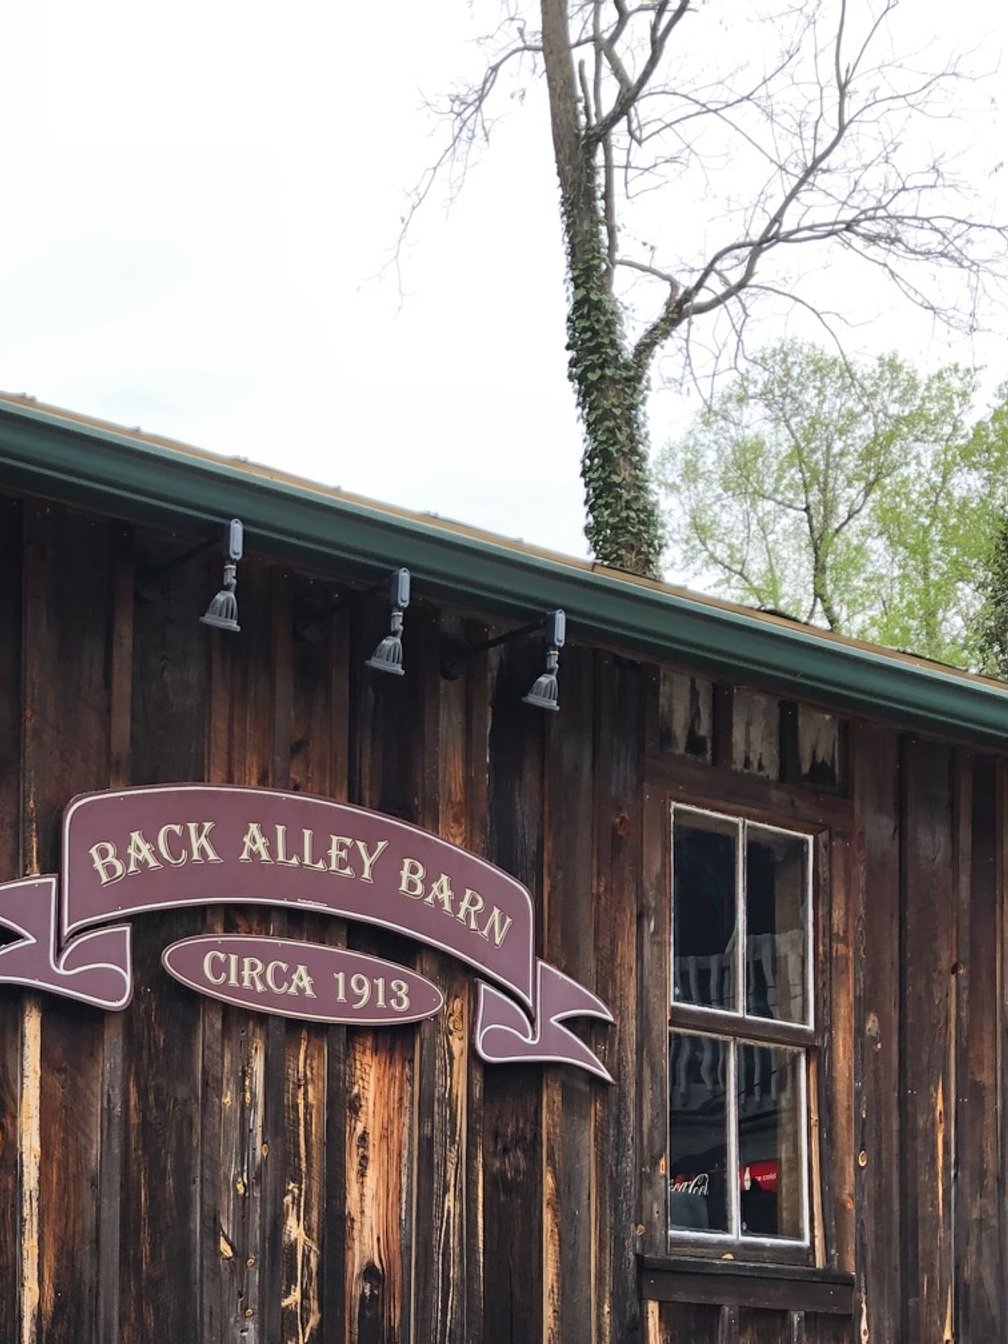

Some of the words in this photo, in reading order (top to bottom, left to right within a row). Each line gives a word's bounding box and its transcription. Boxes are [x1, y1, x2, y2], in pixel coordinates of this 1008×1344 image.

[89, 821, 223, 887] BACK
[239, 822, 389, 883] ALLEY
[398, 857, 513, 949] BARN
[203, 950, 317, 998] CIRCA
[333, 971, 411, 1011] 1913
